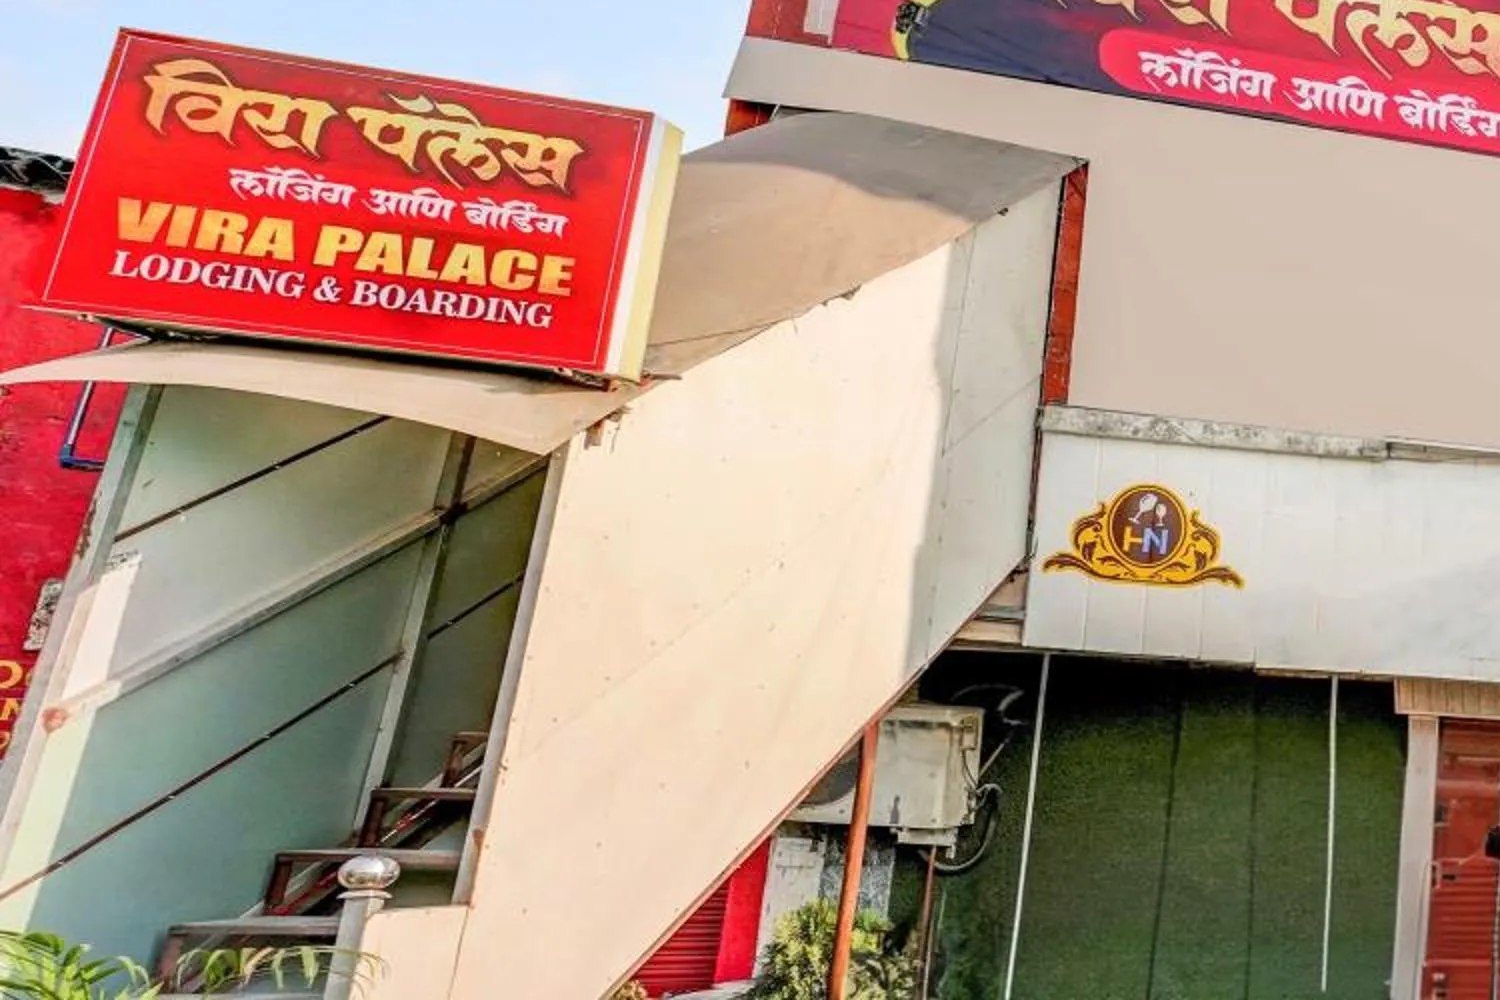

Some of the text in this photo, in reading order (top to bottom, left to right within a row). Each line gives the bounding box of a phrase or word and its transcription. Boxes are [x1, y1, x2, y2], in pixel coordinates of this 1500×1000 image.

[143, 59, 340, 160] विरा
[1138, 47, 1276, 102] लॉजिंग
[1283, 74, 1386, 123] आणि
[366, 186, 457, 224] आणि
[117, 197, 576, 297] VIRA PALACE
[108, 250, 554, 329] LODGING & BOARDING
